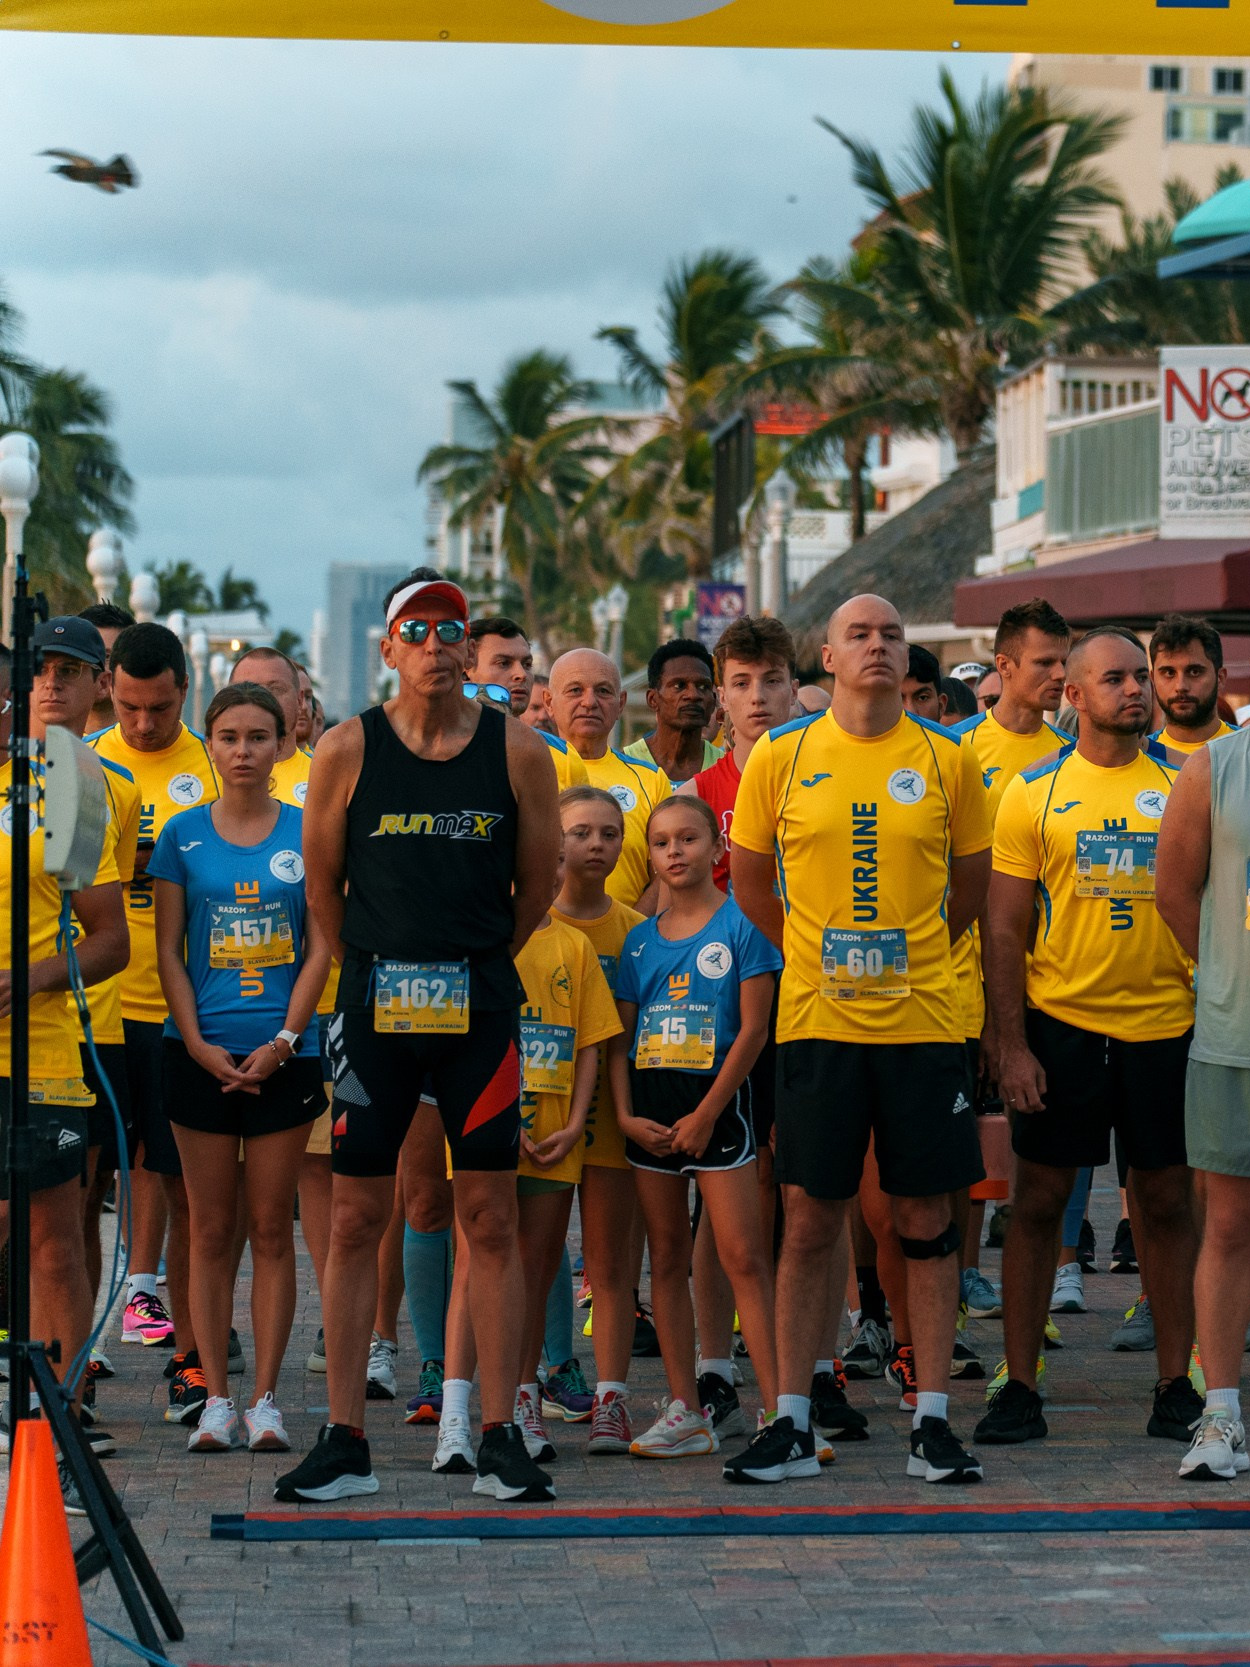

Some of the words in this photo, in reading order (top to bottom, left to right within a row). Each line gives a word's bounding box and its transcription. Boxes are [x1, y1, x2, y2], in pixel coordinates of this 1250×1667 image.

[1086, 834, 1117, 842] RAZOM
[852, 802, 878, 922] UKRAINE
[1105, 848, 1135, 876] 74
[218, 906, 247, 914] RAZOM
[265, 902, 281, 911] RUN
[230, 917, 272, 947] 157
[831, 933, 861, 942] RAZOM
[881, 933, 898, 941] RUN
[385, 964, 418, 972] RAZOM
[847, 948, 884, 978] 60
[396, 978, 448, 1009] 162
[689, 1004, 709, 1012] RUN
[554, 1029, 568, 1037] RUN
[659, 1017, 687, 1045] 15
